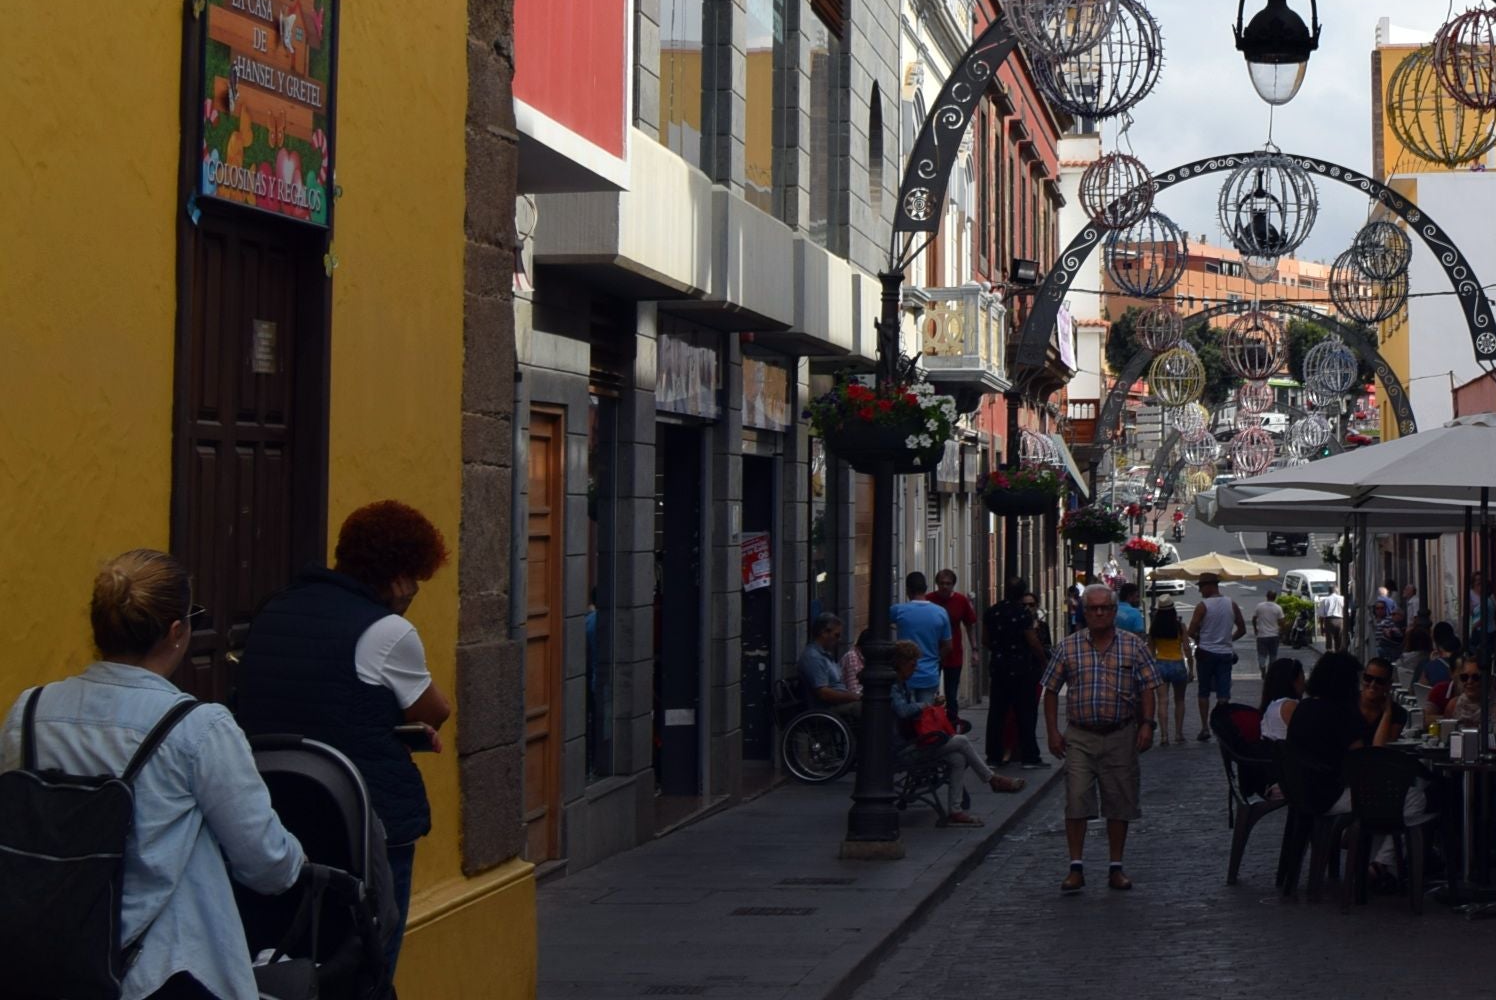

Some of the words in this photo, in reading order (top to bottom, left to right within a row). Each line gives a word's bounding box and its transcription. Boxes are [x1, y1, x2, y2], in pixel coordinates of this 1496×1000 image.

[253, 27, 267, 53] DE
[237, 57, 276, 90] HANSEL
[277, 71, 285, 93] Y
[286, 75, 322, 107] GRETEL
[208, 158, 267, 199] GOLOSINAS
[267, 175, 275, 198] Y
[277, 177, 321, 212] REGALOS
